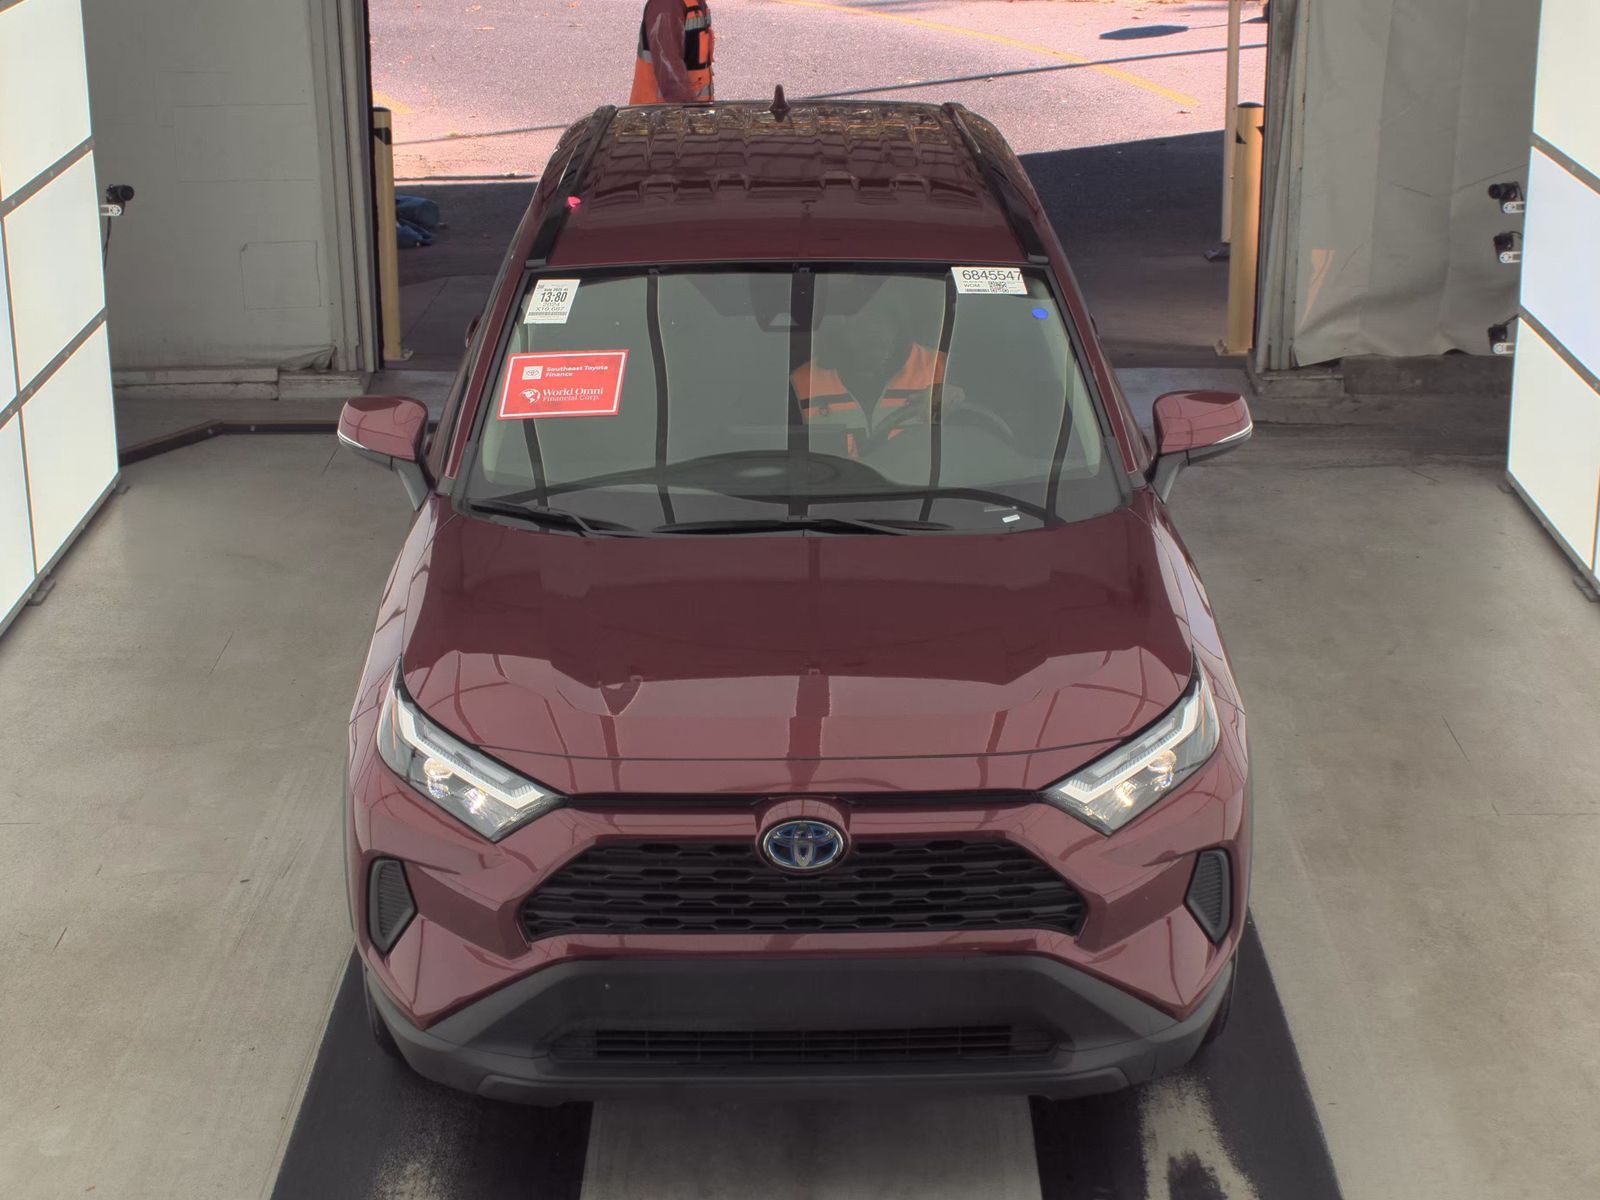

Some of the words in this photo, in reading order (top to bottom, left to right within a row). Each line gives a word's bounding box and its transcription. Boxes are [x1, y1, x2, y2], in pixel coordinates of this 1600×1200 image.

[962, 270, 1021, 280] 6845547
[541, 292, 567, 302] 13:80
[543, 388, 573, 396] World
[574, 386, 604, 395] Omni
[579, 394, 599, 402] Corp.
